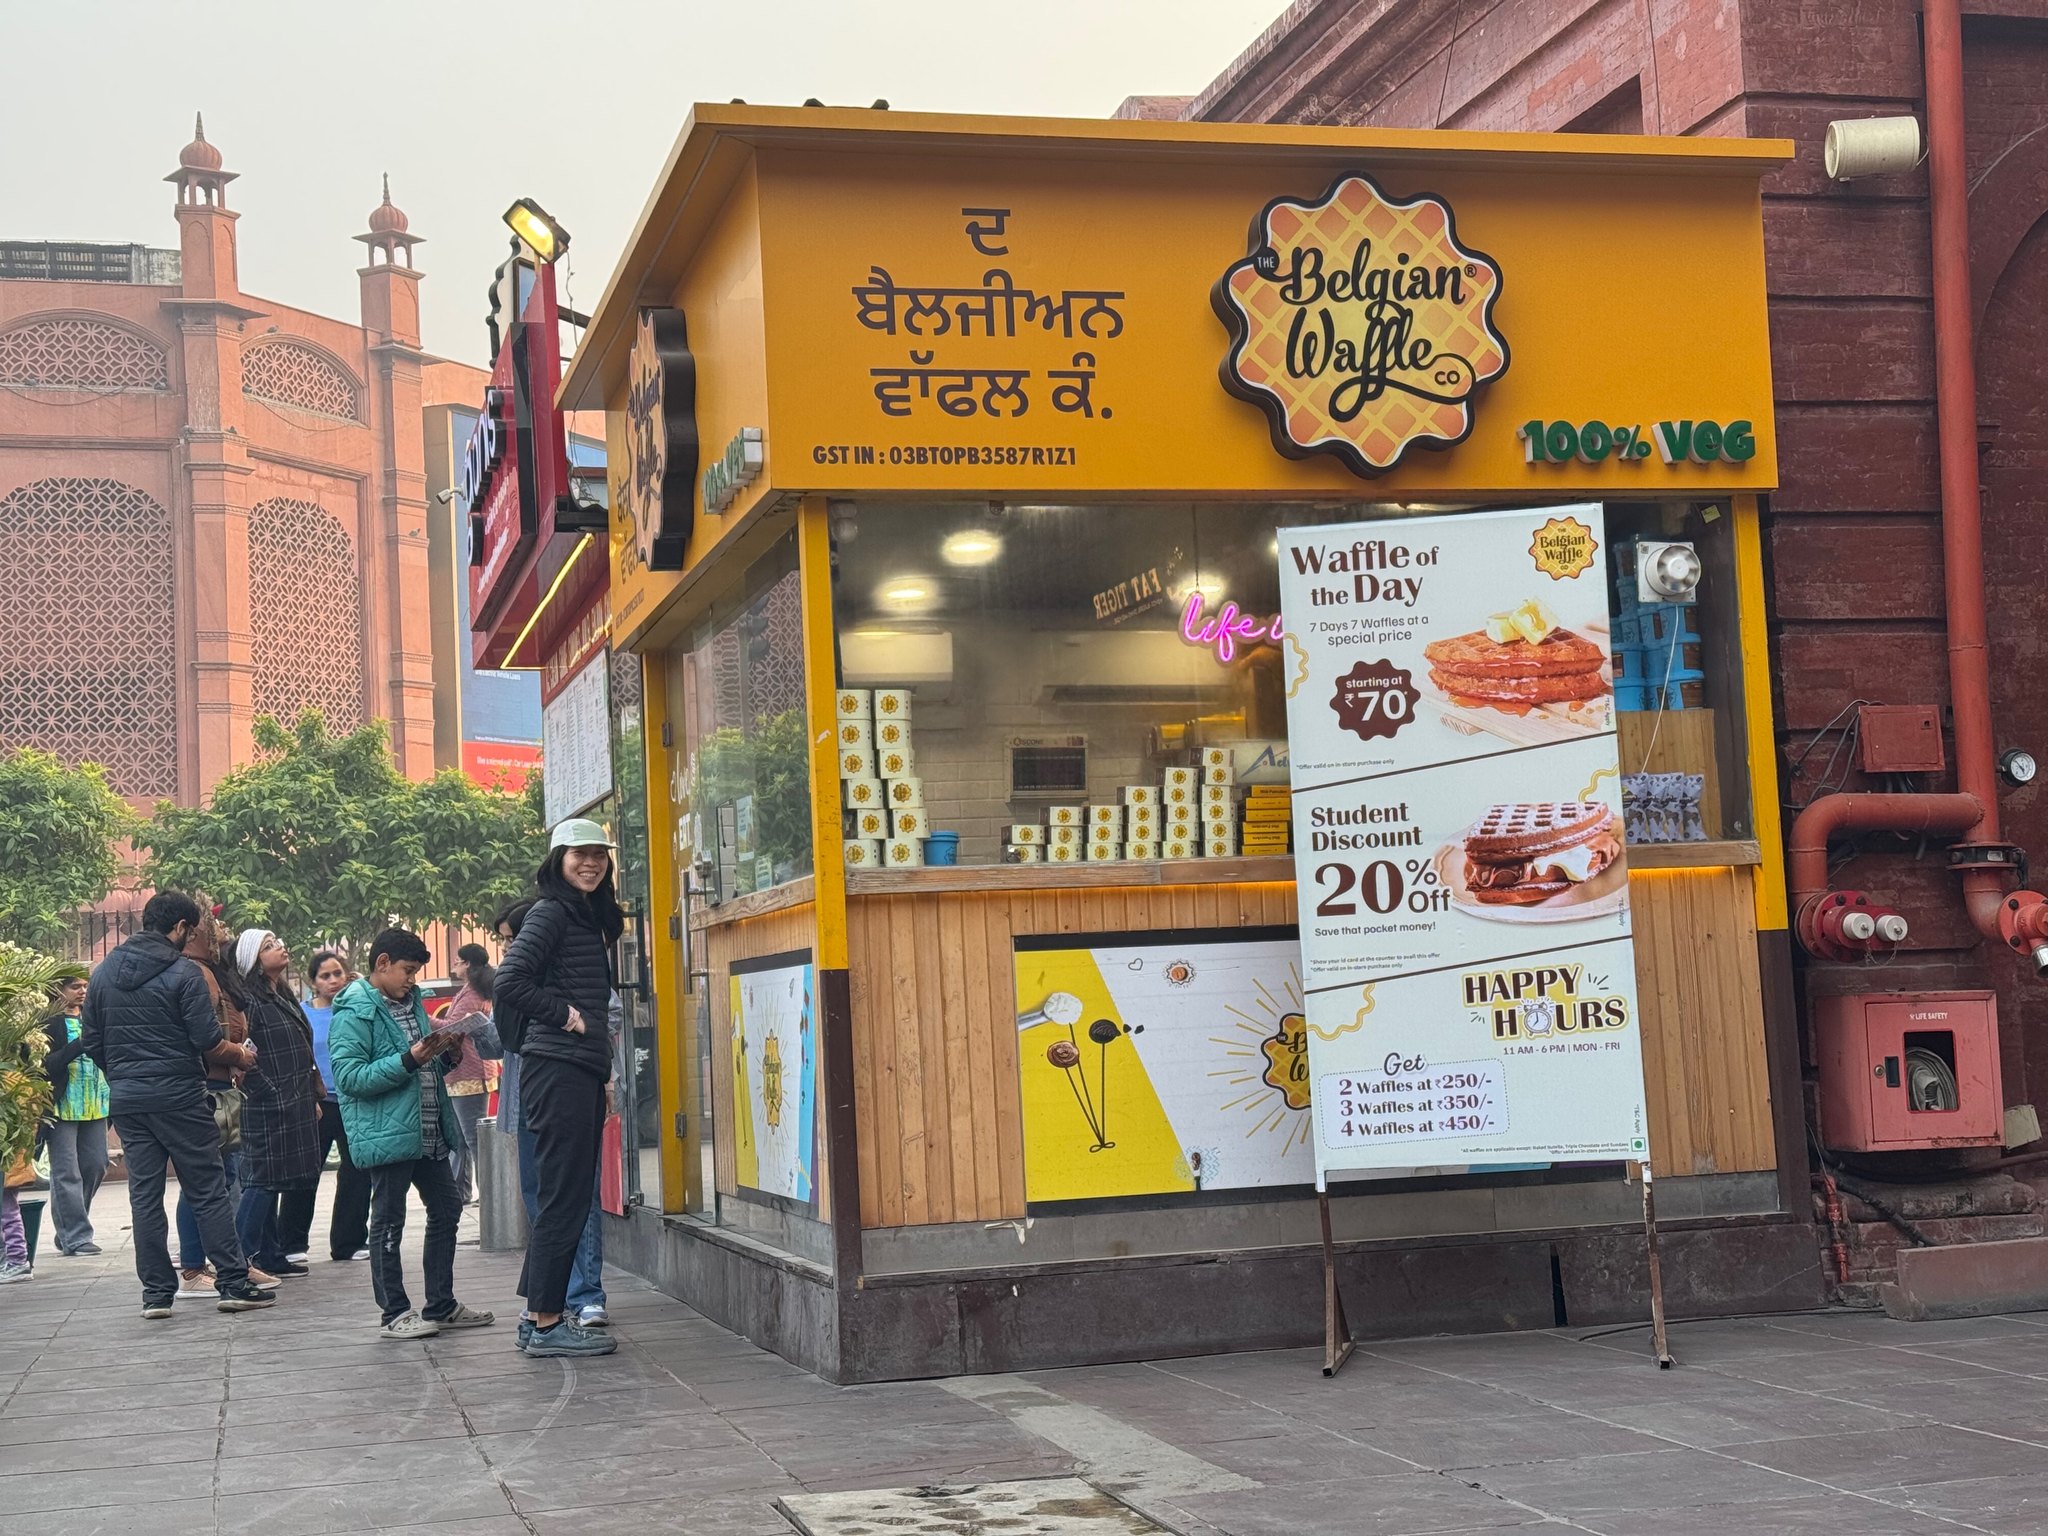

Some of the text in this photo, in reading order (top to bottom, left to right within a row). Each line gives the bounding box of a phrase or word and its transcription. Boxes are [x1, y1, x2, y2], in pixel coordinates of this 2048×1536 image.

[962, 208, 1011, 256] ਦ
[1256, 255, 1275, 269] THE
[852, 265, 1125, 339] ਬੈਲਜੀਅਨ
[1286, 302, 1475, 422] Waffle
[1517, 419, 1652, 467] 100%
[812, 446, 849, 465] GST
[854, 446, 874, 465] IN
[1540, 535, 1586, 549] Belgian
[1290, 541, 1439, 575] Waffle of
[1544, 547, 1583, 564] Waffle
[1311, 573, 1423, 607] the Day
[1184, 593, 1267, 662] life
[1309, 616, 1429, 635] 7 Days 7 Waffles at a
[1328, 629, 1412, 647] special price
[1346, 676, 1402, 692] starting at
[1311, 802, 1409, 828] Student
[1311, 826, 1423, 851] Discount
[1408, 889, 1450, 914] Off
[1314, 921, 1436, 937] Save that pocket money!
[1464, 966, 1581, 1004] HAPPY
[1928, 1012, 1948, 1020] SAFETY
[1503, 1046, 1514, 1055] 11
[1517, 1045, 1534, 1054] AM
[1541, 1044, 1548, 1054] 6
[1549, 1043, 1566, 1053] PM
[1572, 1042, 1598, 1052] MON
[1605, 1041, 1620, 1051] FRI
[1383, 1052, 1425, 1075] Get
[1339, 1079, 1353, 1096] 2
[1356, 1080, 1413, 1094] Waffles
[1416, 1079, 1432, 1091] at
[1340, 1099, 1353, 1117] 3
[1357, 1101, 1414, 1115] Waffles
[1417, 1100, 1433, 1112] at
[1340, 1120, 1354, 1137] 4
[1358, 1121, 1415, 1136] Waffles
[1418, 1121, 1434, 1133] at
